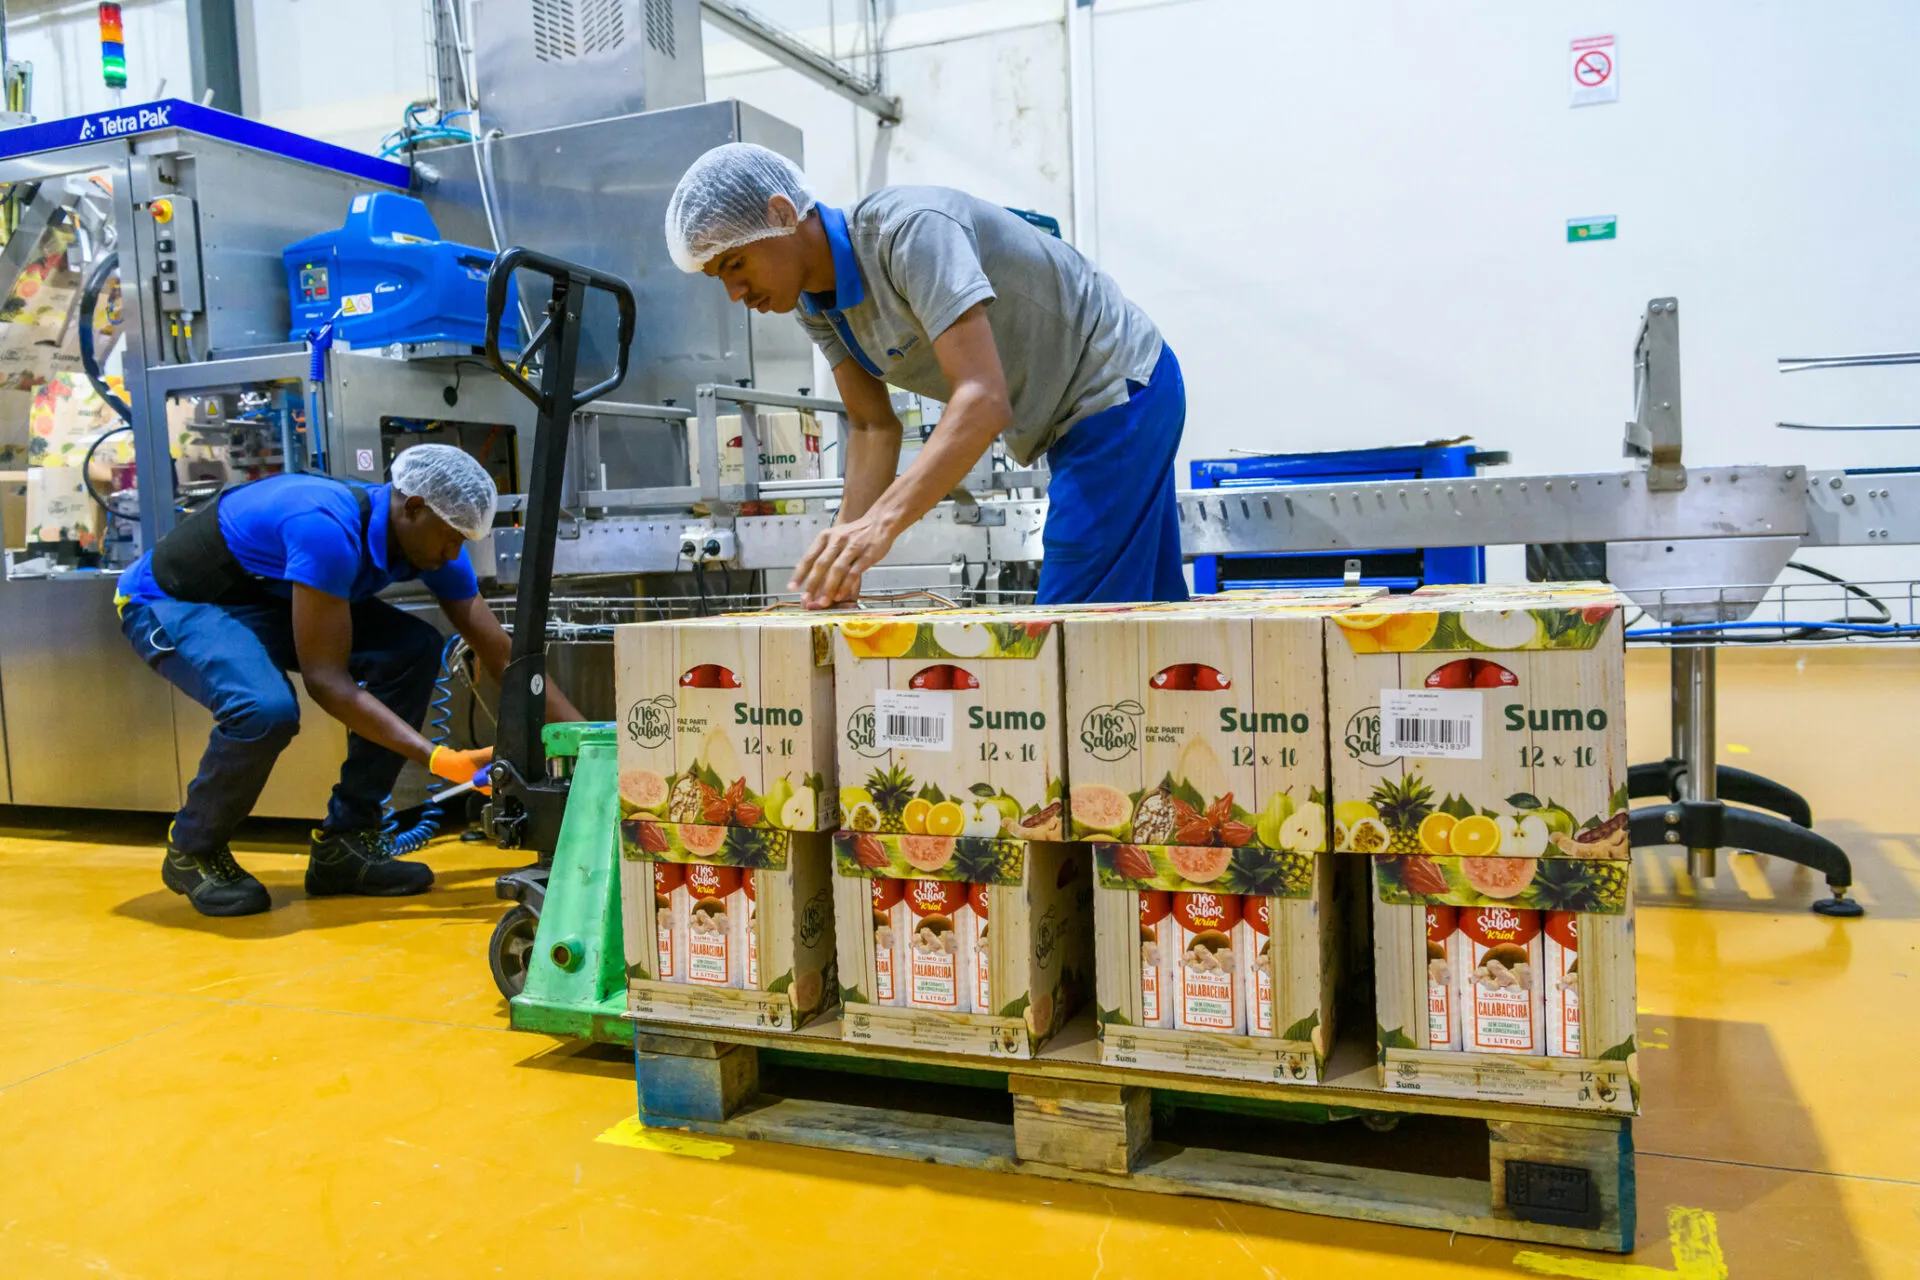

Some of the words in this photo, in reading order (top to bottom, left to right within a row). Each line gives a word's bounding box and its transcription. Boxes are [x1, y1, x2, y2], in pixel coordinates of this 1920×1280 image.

[99, 116, 137, 135] Tetra
[139, 107, 169, 128] Pak
[758, 453, 796, 465] Sumo
[734, 703, 803, 726] Sumo
[968, 705, 1046, 731] Sumo
[1220, 707, 1309, 733] Sumo
[1504, 704, 1608, 731] Sumo
[1145, 726, 1159, 734] FAZ
[1161, 726, 1185, 734] PARTE
[743, 737, 761, 755] 12
[766, 745, 776, 754] x
[847, 729, 875, 750] Sab
[1145, 735, 1155, 743] DE
[1344, 734, 1380, 759] Sab
[979, 742, 998, 761] 12
[1005, 750, 1015, 760] x
[1232, 746, 1254, 766] 12
[1261, 754, 1272, 766] x
[1519, 746, 1545, 768] 12
[1552, 755, 1566, 766] x
[691, 943, 723, 957] CALABACEIRA
[914, 963, 952, 978] CALABACEIRA
[1187, 983, 1229, 999] CALABACEIRA
[1478, 1001, 1527, 1018] CALABACEIRA
[1199, 1016, 1224, 1024] LITRO
[852, 1031, 871, 1039] Sumo
[1115, 1054, 1137, 1063] Sumo
[1396, 1081, 1421, 1090] Sumo
